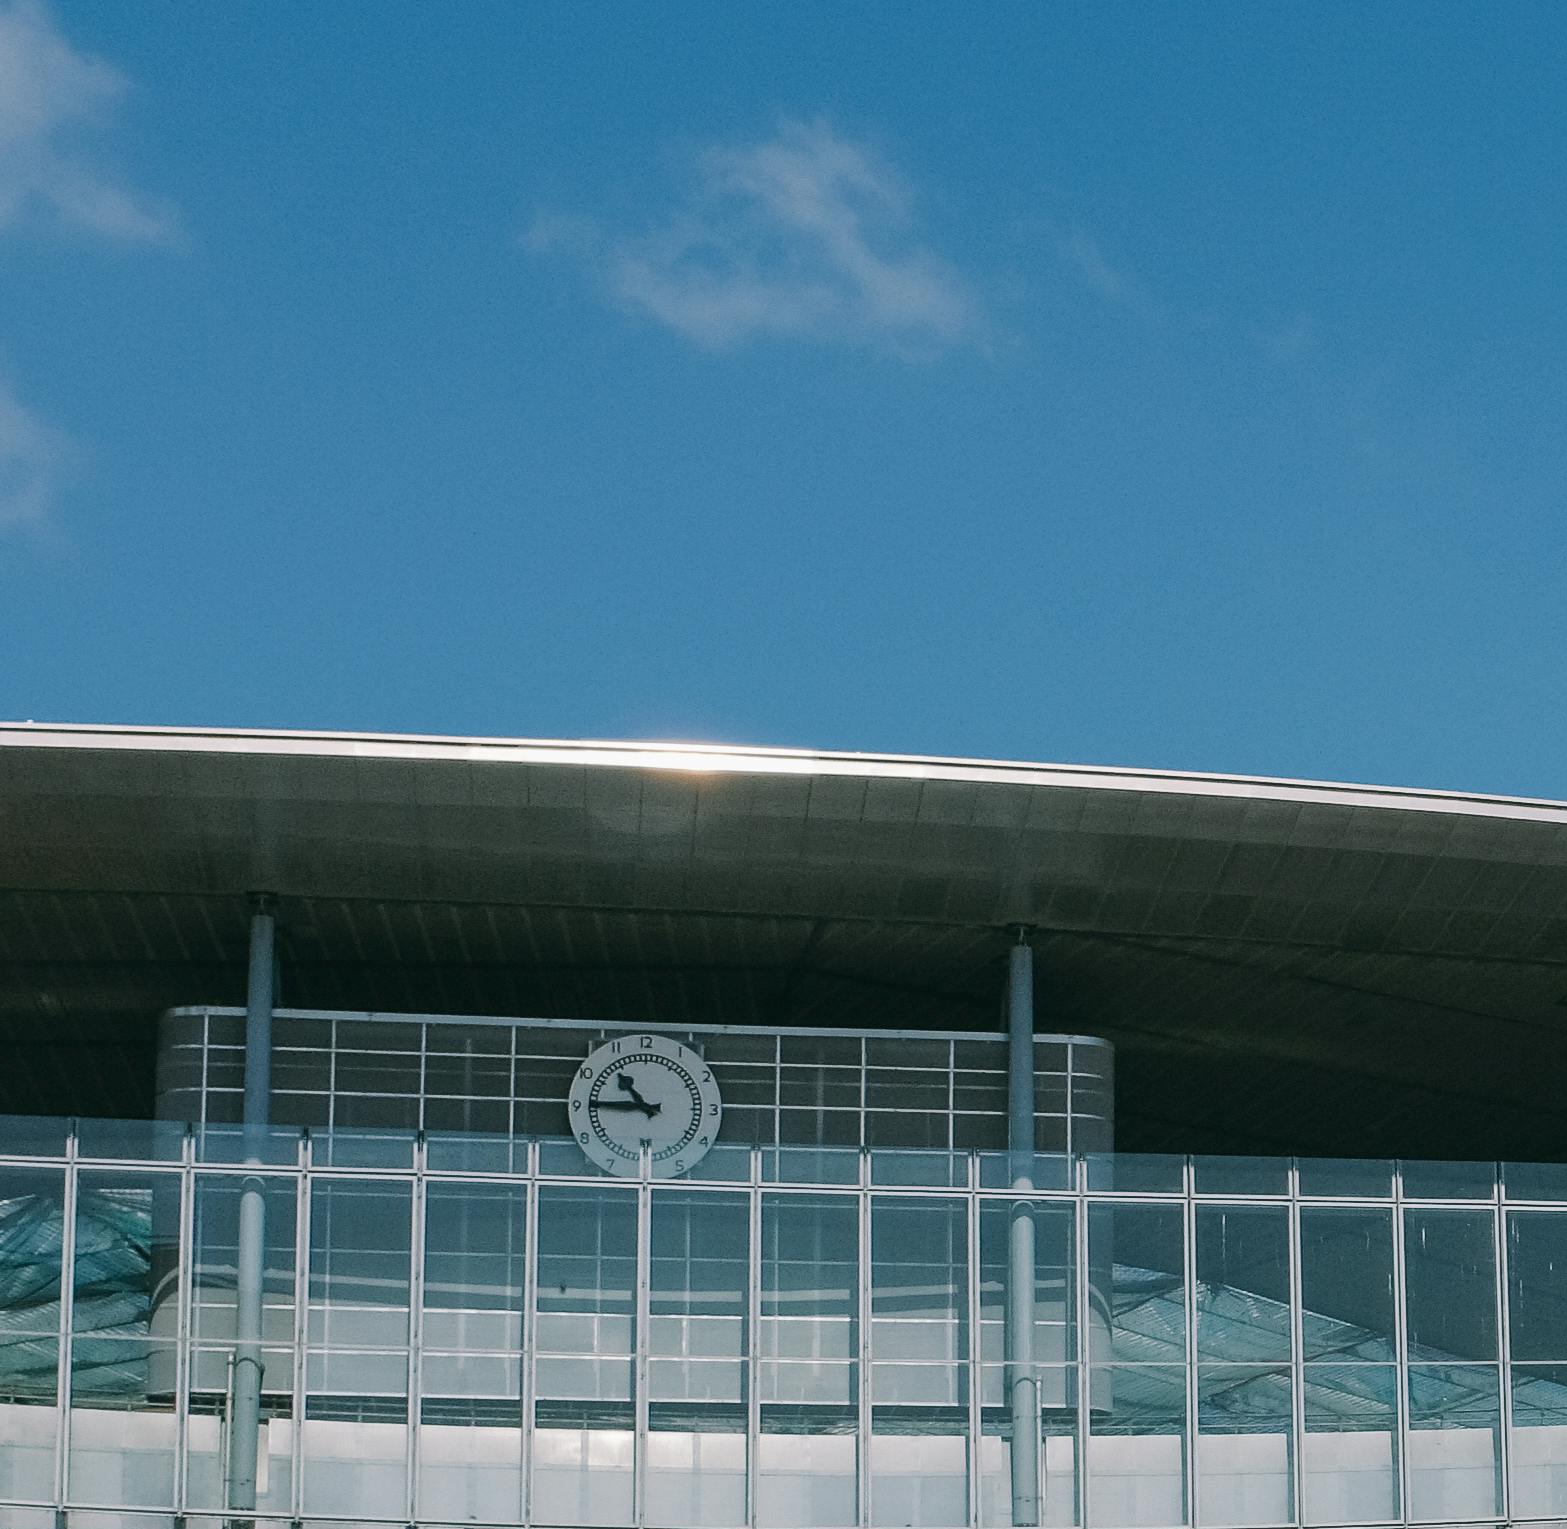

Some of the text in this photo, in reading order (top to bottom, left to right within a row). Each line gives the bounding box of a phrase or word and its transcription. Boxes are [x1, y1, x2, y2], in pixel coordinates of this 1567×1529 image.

[612, 1041, 621, 1053] 11
[640, 1036, 653, 1048] 12
[579, 1067, 594, 1079] 10
[702, 1071, 711, 1082] 2
[572, 1101, 582, 1112] 9
[709, 1104, 719, 1116] 3
[580, 1132, 590, 1144] 8
[701, 1136, 709, 1148] 4
[606, 1158, 615, 1169] 7
[675, 1160, 685, 1172] 5
